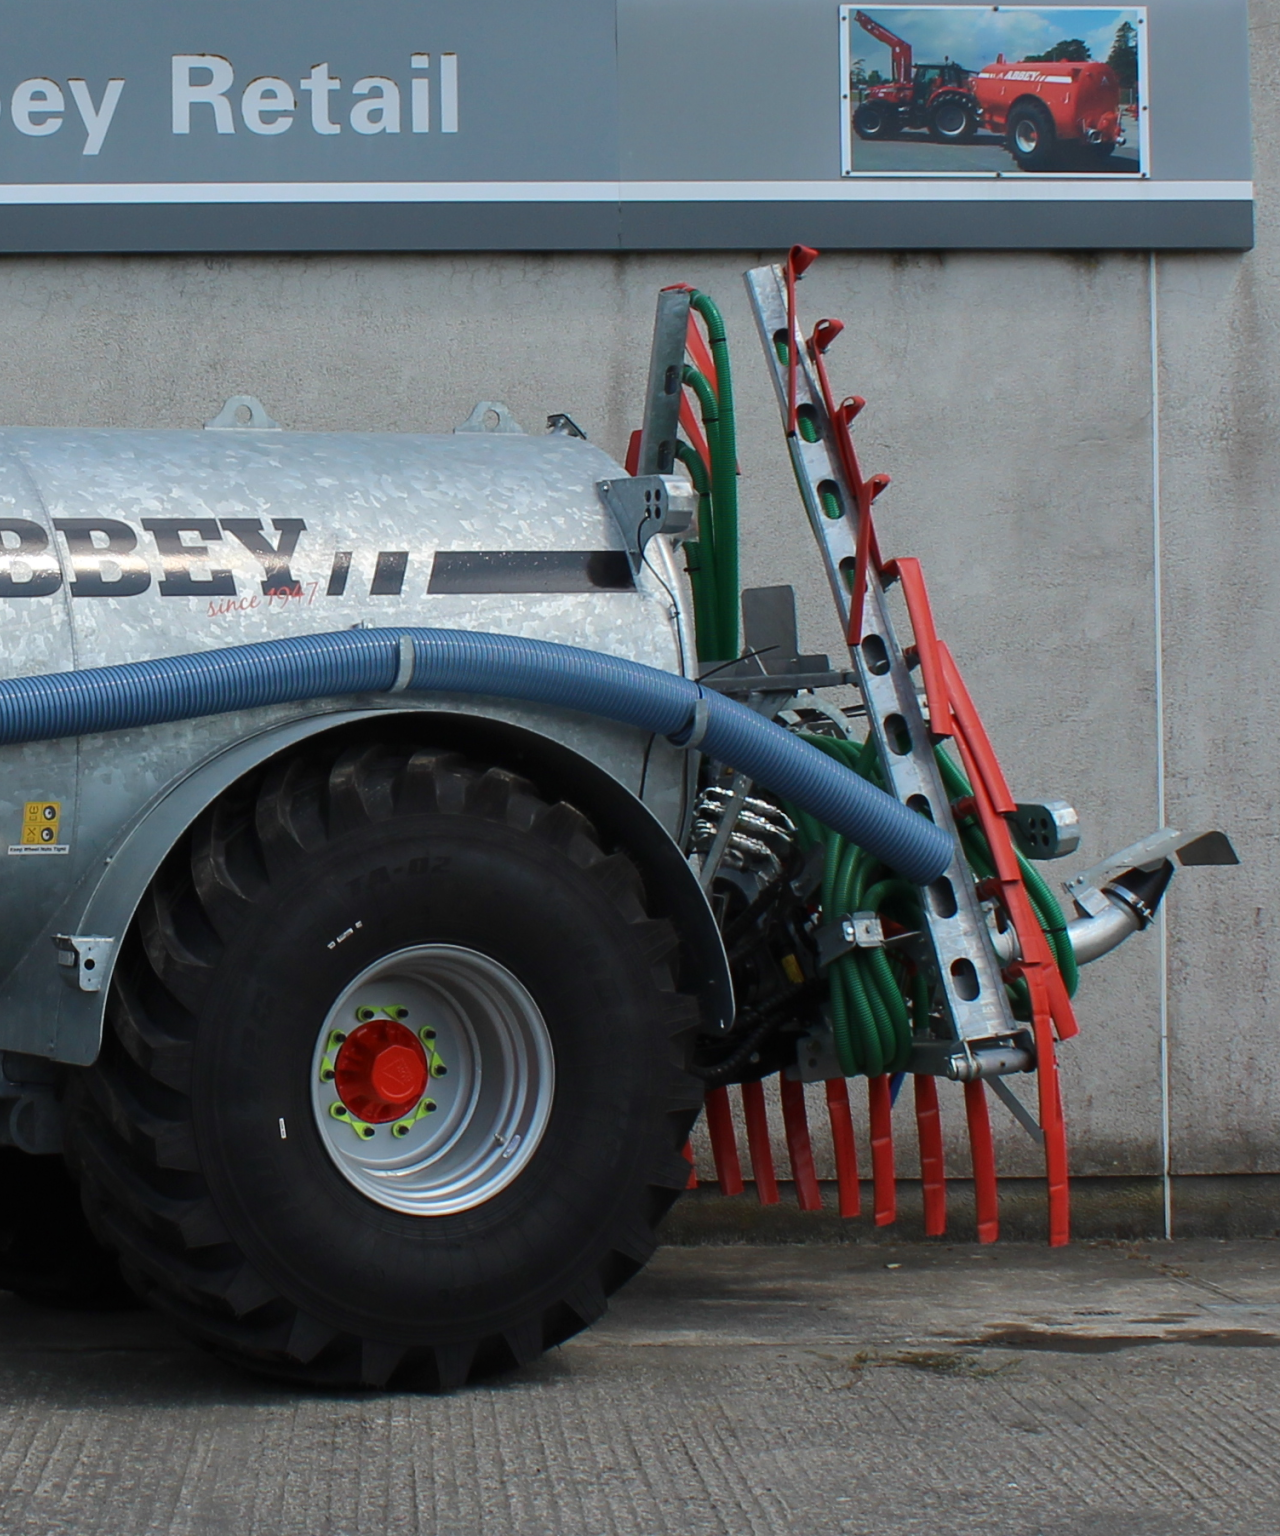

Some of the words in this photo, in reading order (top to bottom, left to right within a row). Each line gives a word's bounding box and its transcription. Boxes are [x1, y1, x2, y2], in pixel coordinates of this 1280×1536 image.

[170, 52, 459, 135] Retail
[206, 594, 262, 618] since
[266, 581, 319, 610] 1947
